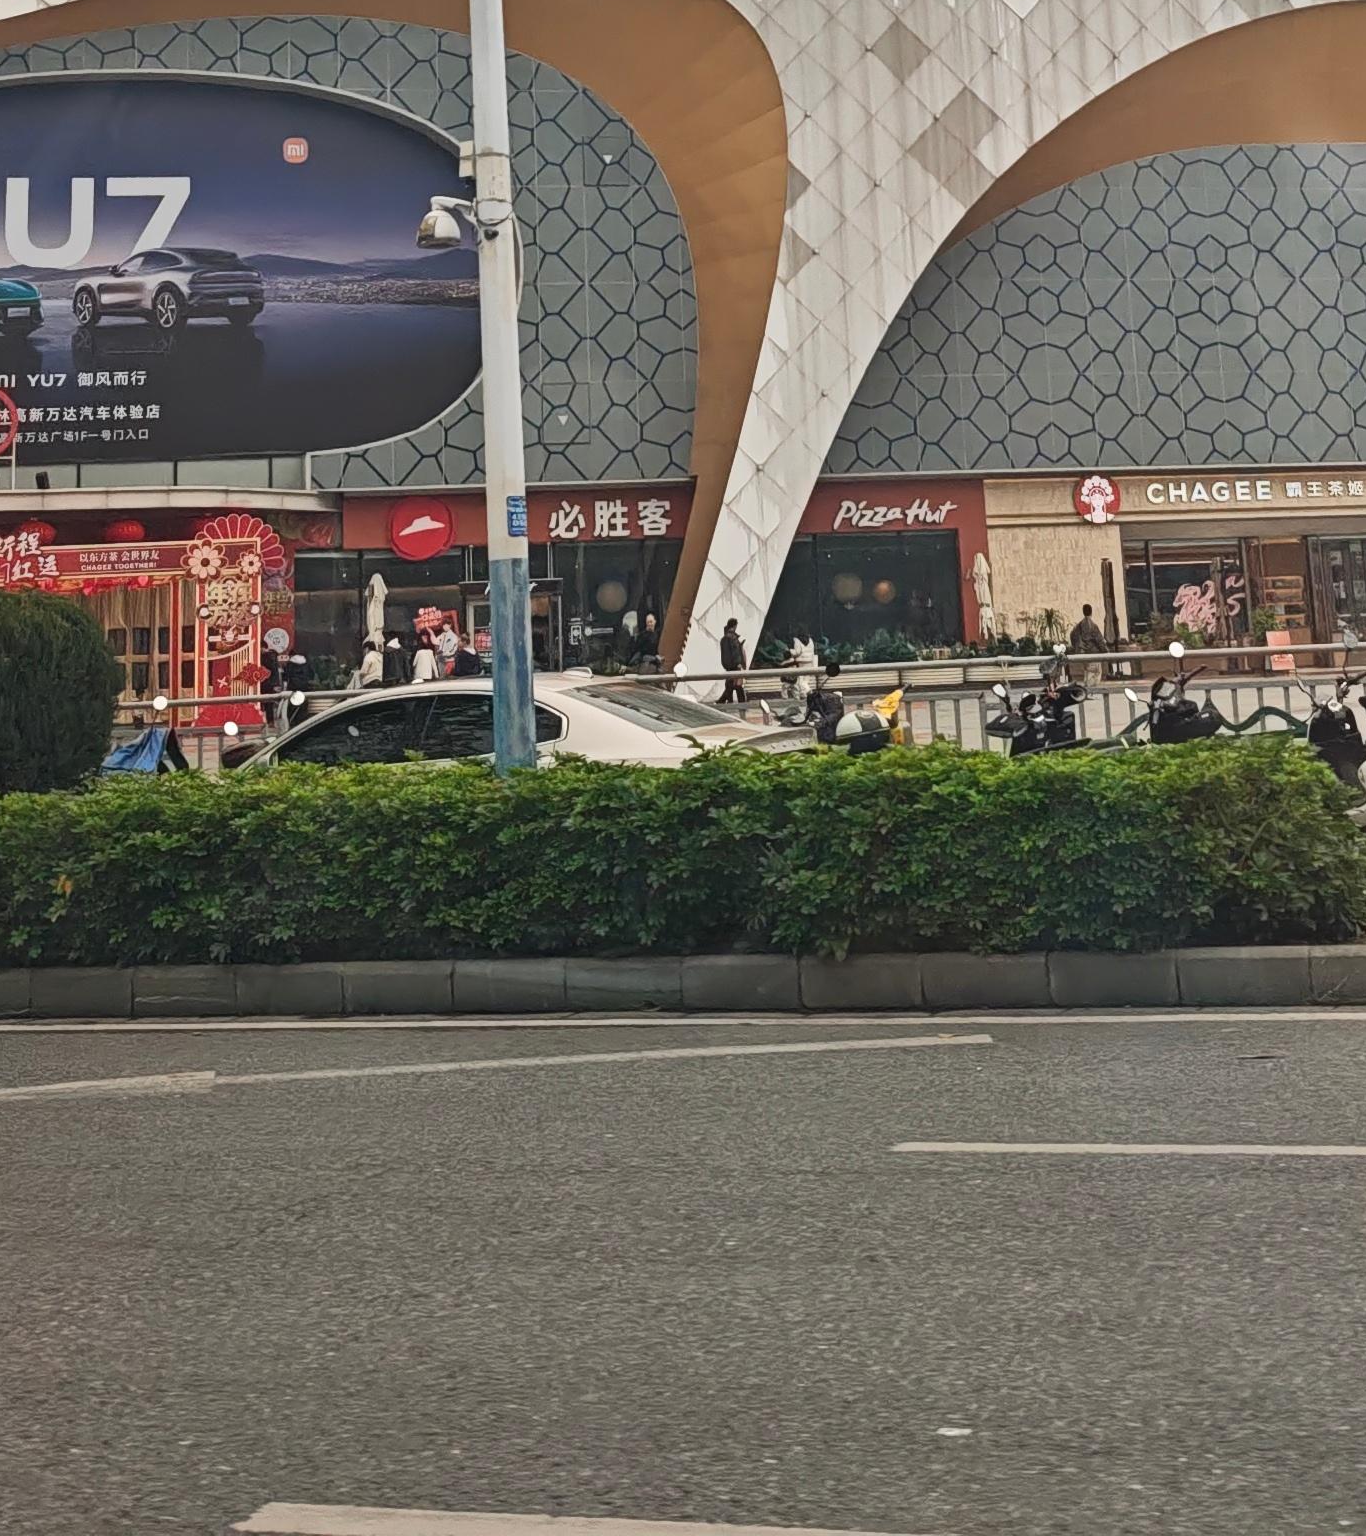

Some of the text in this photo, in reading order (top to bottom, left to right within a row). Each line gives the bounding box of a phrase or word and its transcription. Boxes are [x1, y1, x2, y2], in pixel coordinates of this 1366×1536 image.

[26, 373, 67, 387] YU7
[77, 370, 147, 387] 御风而行
[1146, 479, 1366, 505] CHAGEE 霸王茶姬
[548, 498, 673, 540] 必胜客
[833, 498, 958, 531] Pizza Hut
